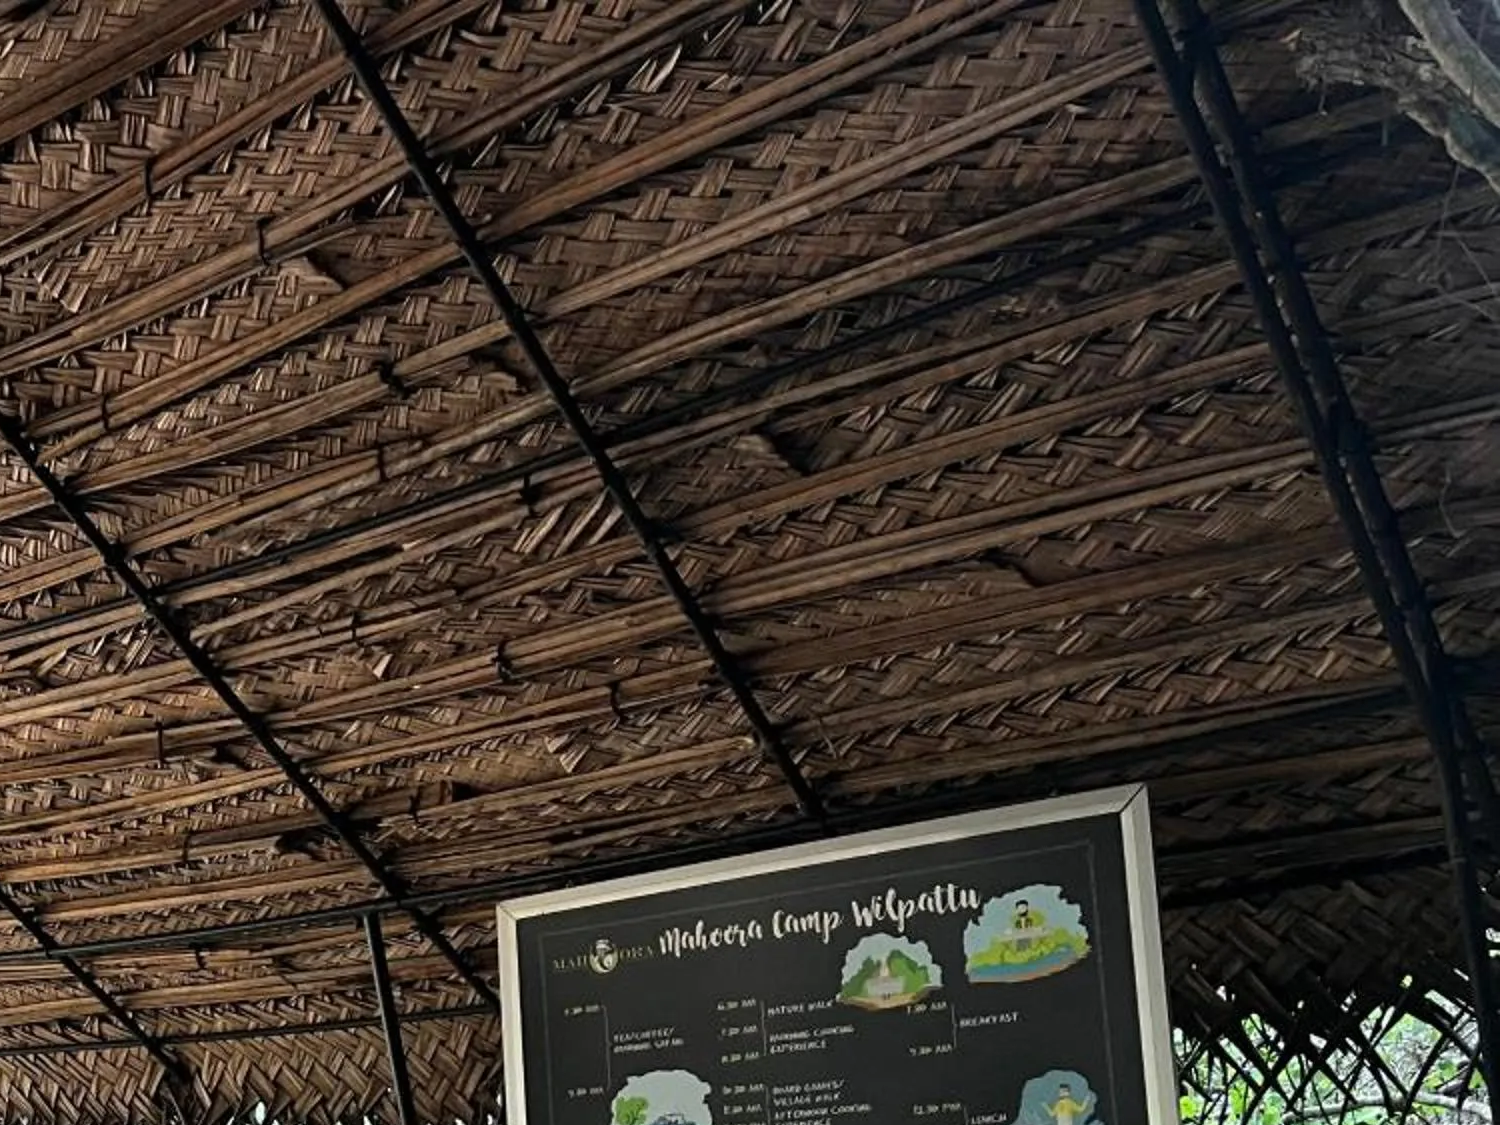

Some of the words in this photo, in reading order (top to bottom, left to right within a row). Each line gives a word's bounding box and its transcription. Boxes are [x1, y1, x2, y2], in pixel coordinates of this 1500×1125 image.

[659, 919, 763, 958] Mahoora
[771, 909, 843, 944] Camp
[851, 883, 982, 933] Wilpattu
[767, 1003, 804, 1016] NATURE
[807, 999, 833, 1011] WALK
[959, 1011, 1019, 1029] BREAKFAST
[769, 1040, 826, 1055] EXPERIENCE
[772, 1095, 811, 1107] VILLAGE
[971, 1112, 1007, 1125] LUNCH
